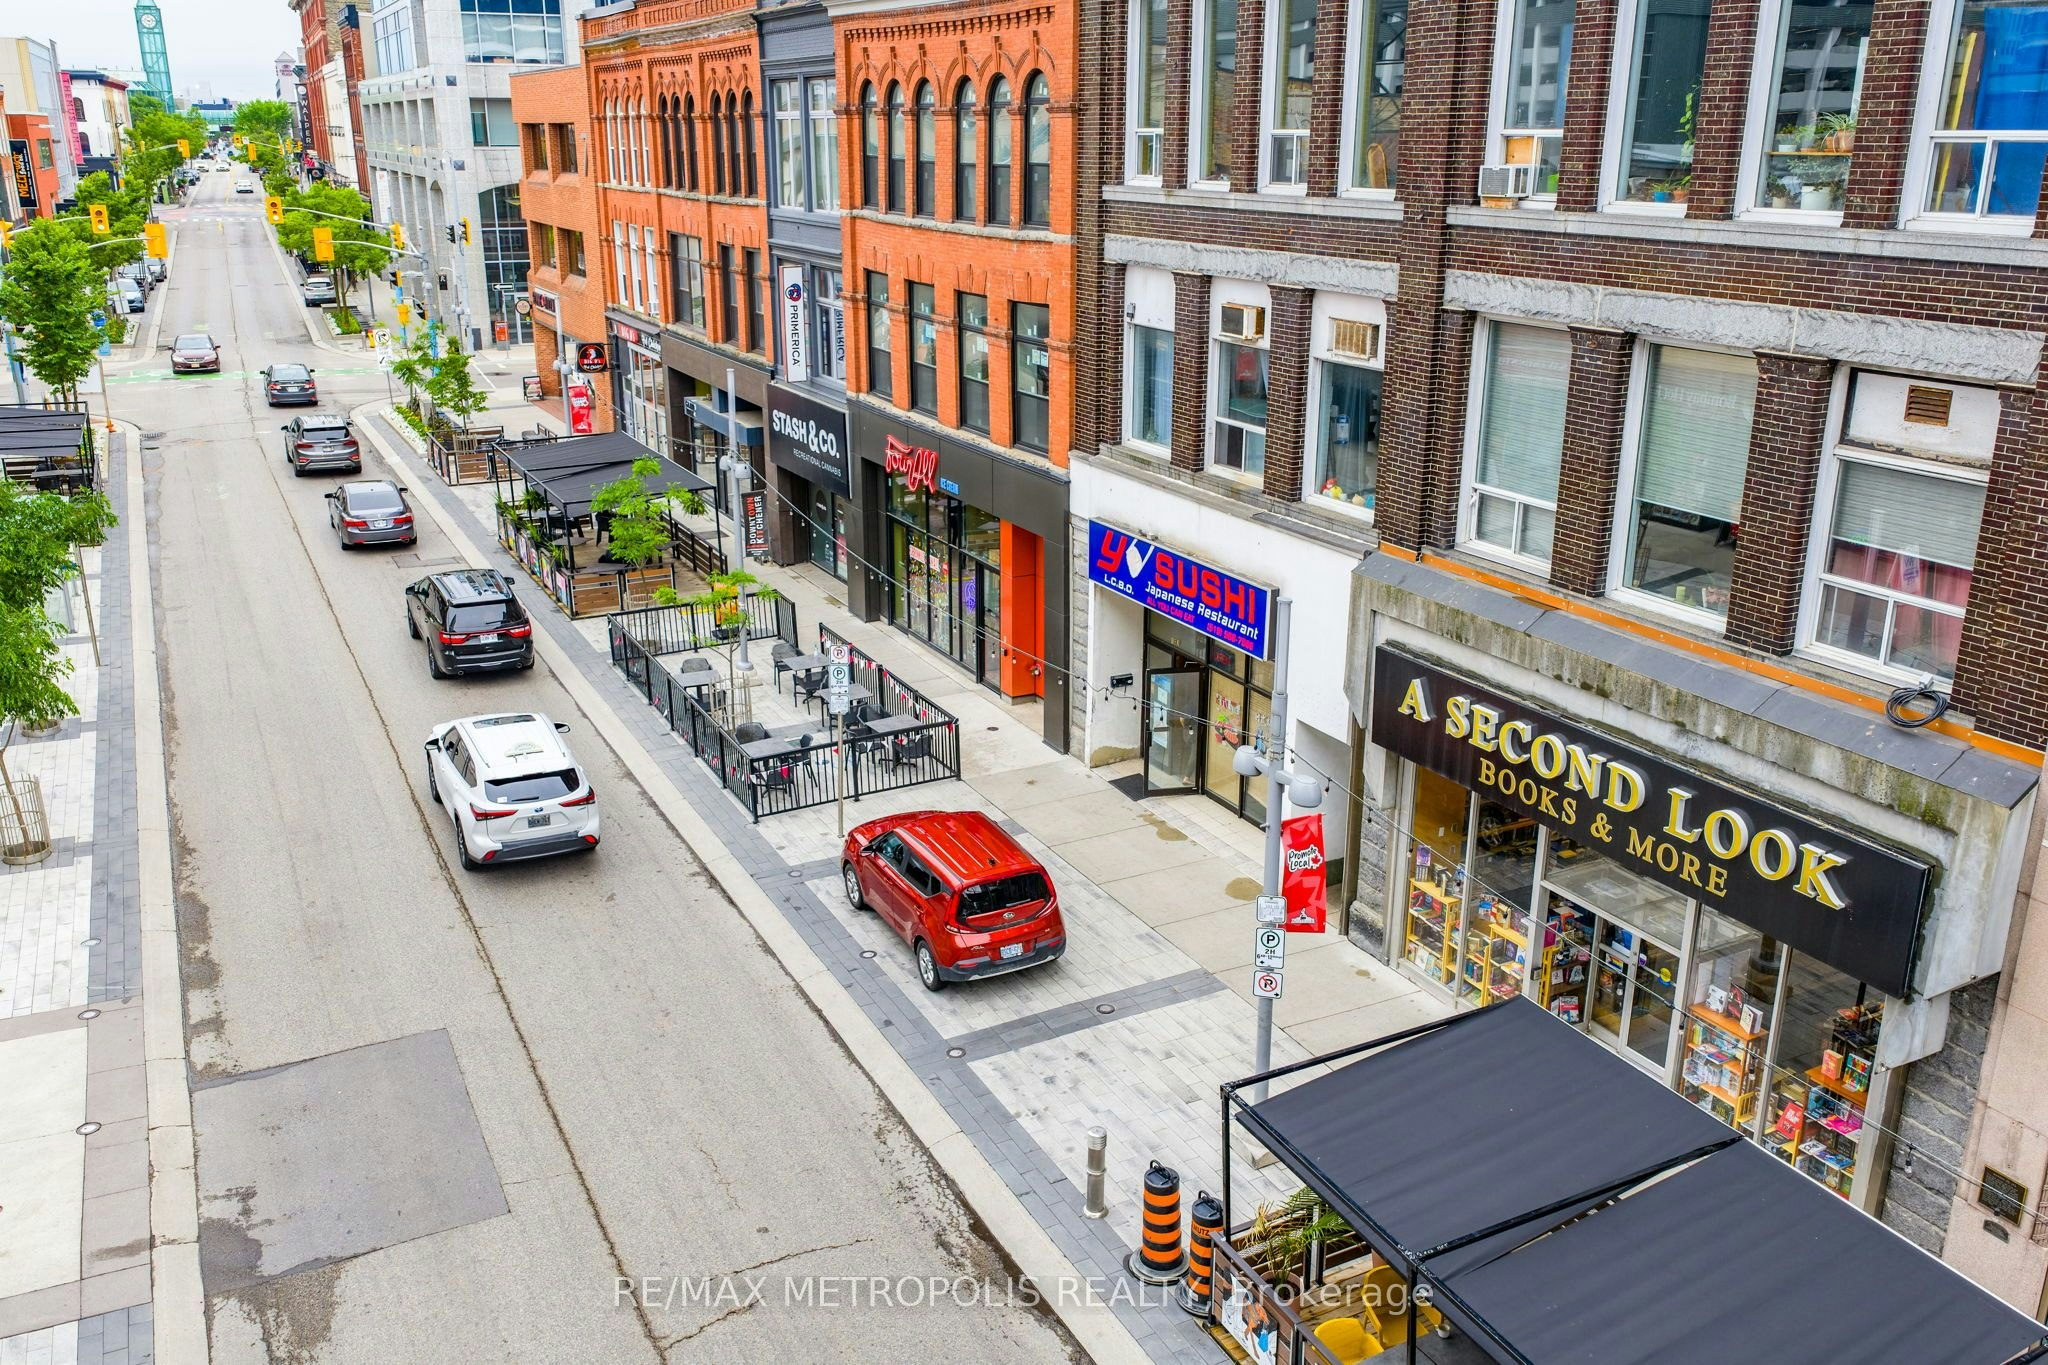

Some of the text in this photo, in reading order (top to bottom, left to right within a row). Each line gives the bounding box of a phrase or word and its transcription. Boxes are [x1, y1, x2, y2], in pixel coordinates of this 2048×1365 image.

[300, 100, 311, 144] WALPER
[790, 305, 800, 365] PRIMERICA
[793, 448, 842, 478] RECREATIONAL CANNABIS
[746, 497, 756, 544] DOWNTOWN
[754, 496, 764, 544] KITCHENER
[1145, 581, 1258, 640] Japanese Restaurant
[1155, 552, 1255, 624] SUSHI
[1398, 677, 1848, 910] A SECOND LOOK
[1479, 757, 1728, 898] BOOKS & MORE
[1289, 846, 1316, 861] Promote
[1290, 858, 1310, 870] Local
[1267, 935, 1275, 944] P
